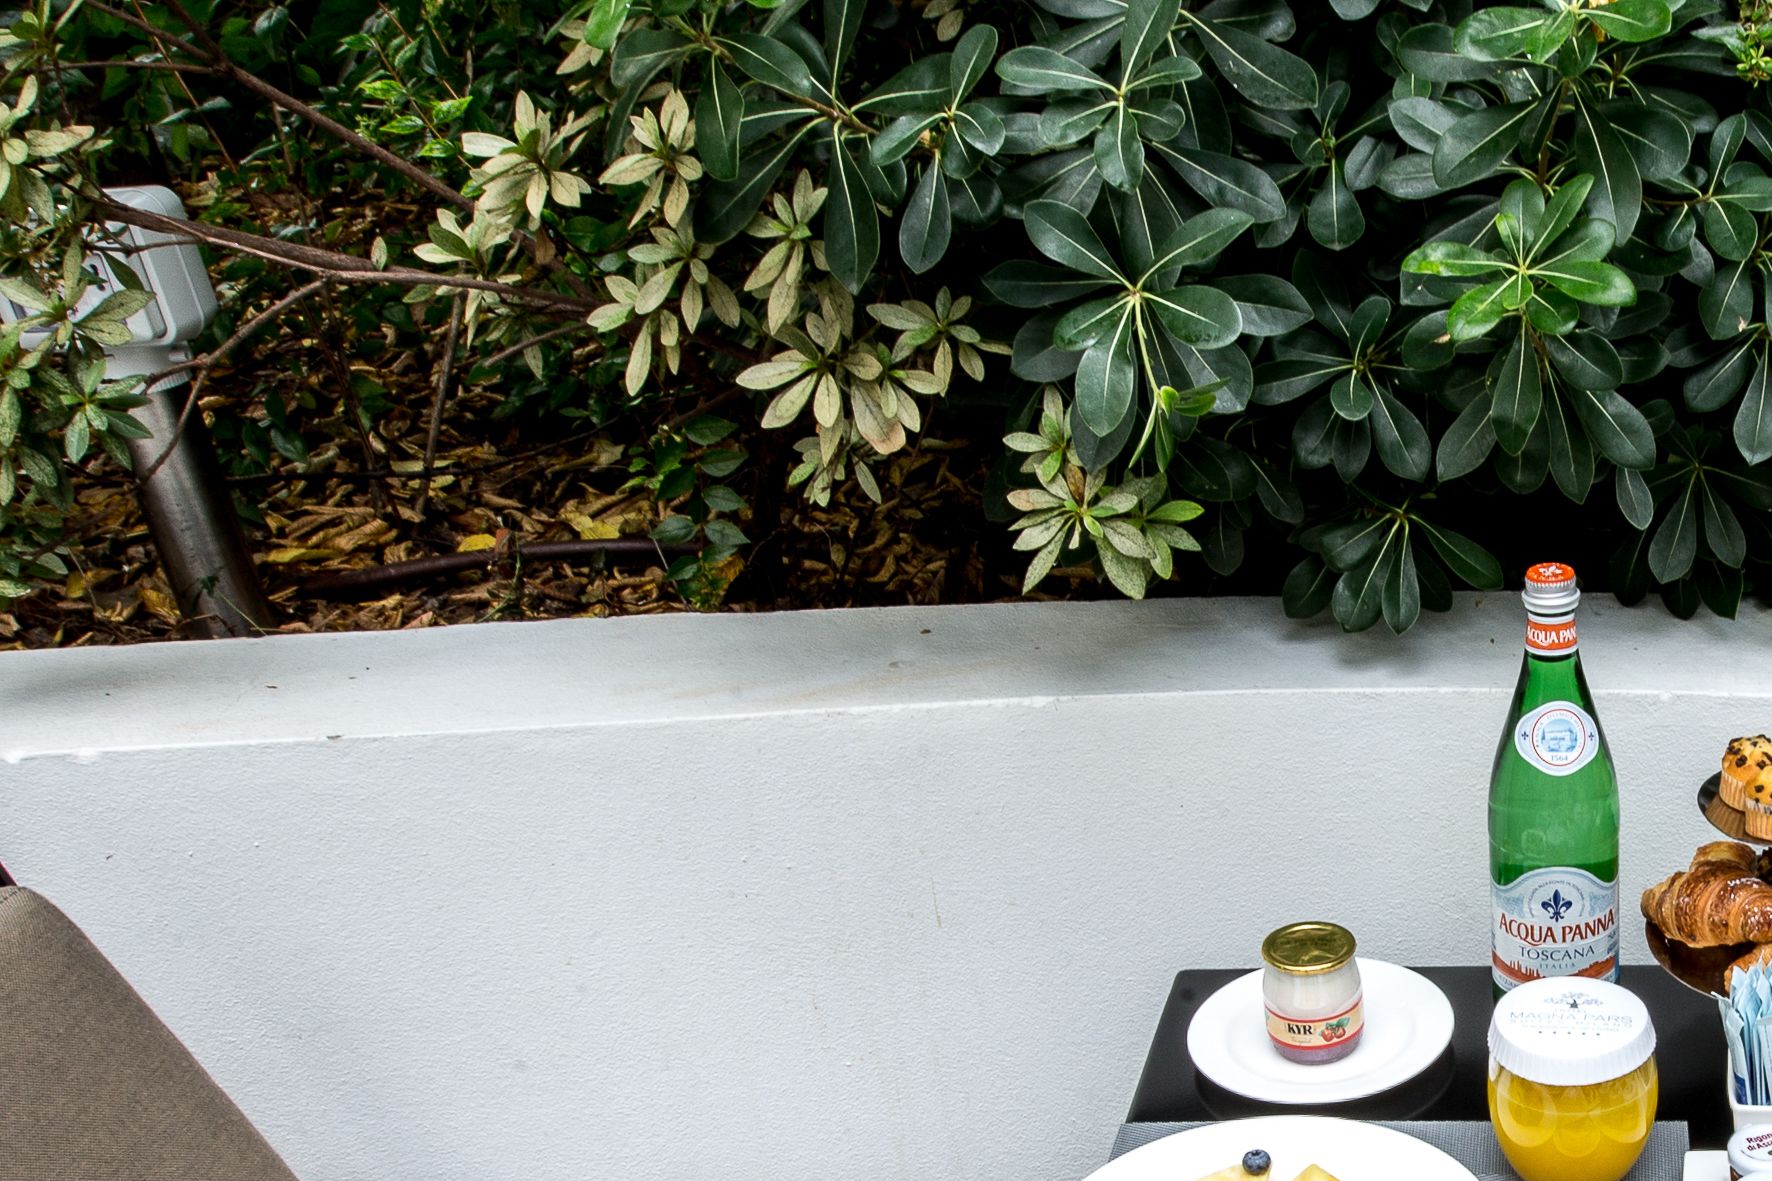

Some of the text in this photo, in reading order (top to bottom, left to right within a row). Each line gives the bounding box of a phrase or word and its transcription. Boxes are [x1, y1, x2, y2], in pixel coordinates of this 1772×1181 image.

[1527, 625, 1559, 646] ACQUA
[1500, 912, 1557, 946] ACQUA
[1561, 908, 1615, 943] PANNA
[1519, 945, 1595, 961] TOSCANA
[1510, 1011, 1633, 1024] MAGNA PARS
[1286, 1022, 1313, 1035] KYR
